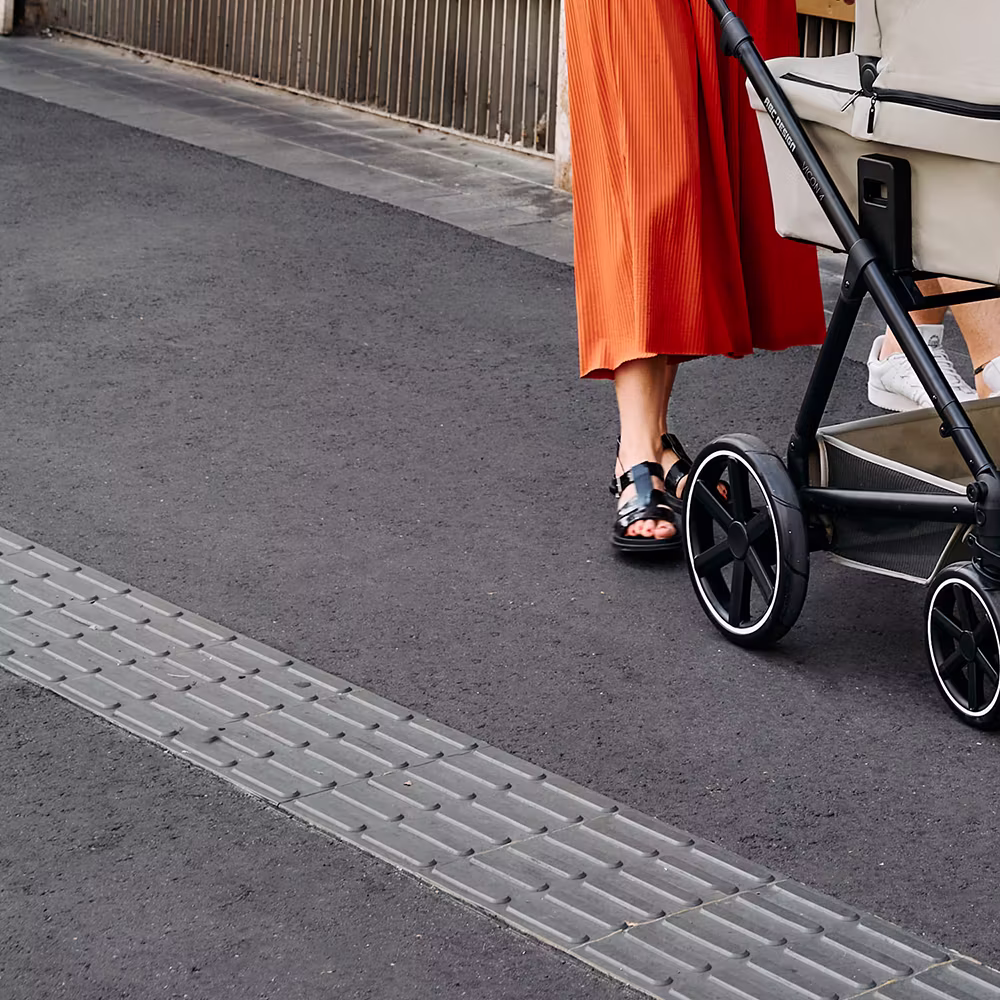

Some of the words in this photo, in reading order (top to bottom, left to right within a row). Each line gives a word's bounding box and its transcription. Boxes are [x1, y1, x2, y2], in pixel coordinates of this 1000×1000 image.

[764, 97, 777, 118] ABC
[775, 116, 796, 152] DESIGN
[802, 161, 821, 194] VICON
